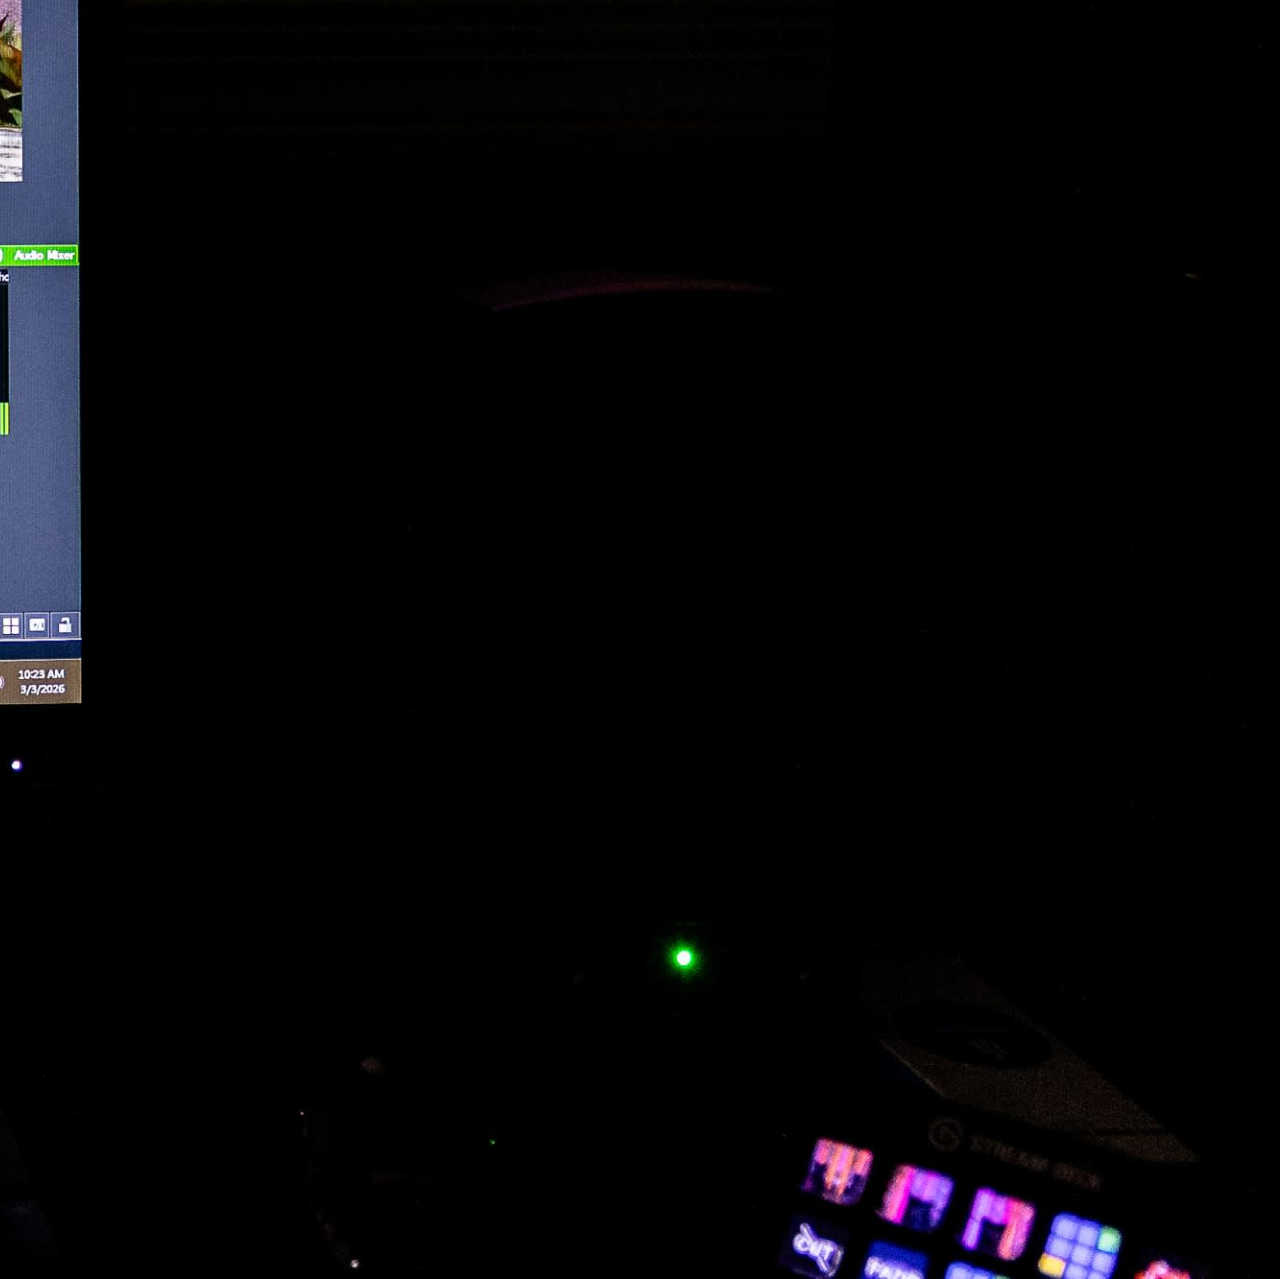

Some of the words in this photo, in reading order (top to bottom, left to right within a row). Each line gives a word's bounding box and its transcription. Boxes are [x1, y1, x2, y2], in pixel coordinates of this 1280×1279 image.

[14, 251, 44, 261] Audio
[47, 251, 75, 261] Mixer
[18, 670, 45, 680] 10:23
[47, 669, 65, 679] AM
[20, 684, 65, 695] 3/3/2026
